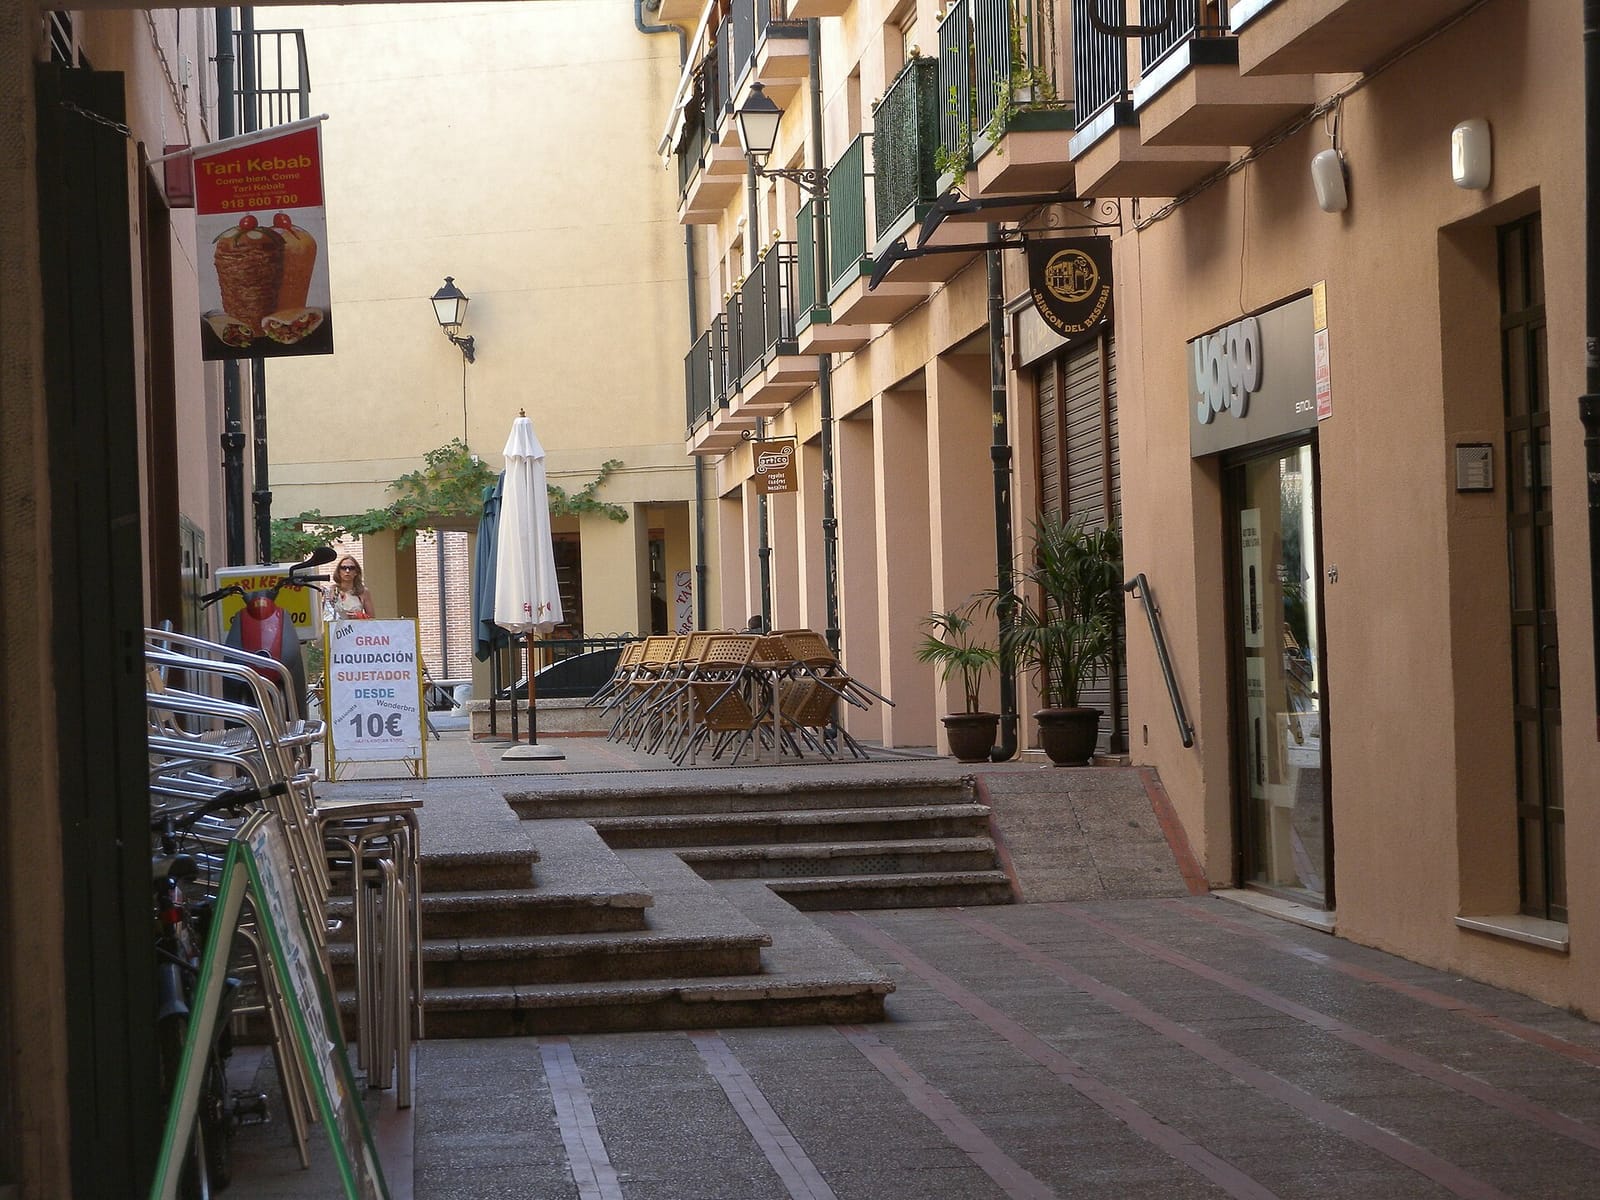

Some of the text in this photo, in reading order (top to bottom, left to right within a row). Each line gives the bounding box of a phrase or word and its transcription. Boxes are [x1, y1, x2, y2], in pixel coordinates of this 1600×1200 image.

[202, 155, 312, 176] Tari Kebab
[272, 173, 300, 181] Come
[233, 182, 285, 193] Tari Kebab
[222, 200, 245, 209] 918
[248, 197, 272, 207] 800
[275, 194, 298, 205] 700
[1064, 324, 1086, 333] DEL
[335, 624, 354, 640] DIM
[355, 635, 390, 646] GRAN
[333, 651, 413, 664] LIQUIDACIÓN
[337, 671, 411, 682] SUJETADOR
[354, 688, 395, 699] DESDE
[376, 699, 416, 713] Wonderbra
[350, 713, 403, 738] 10€
